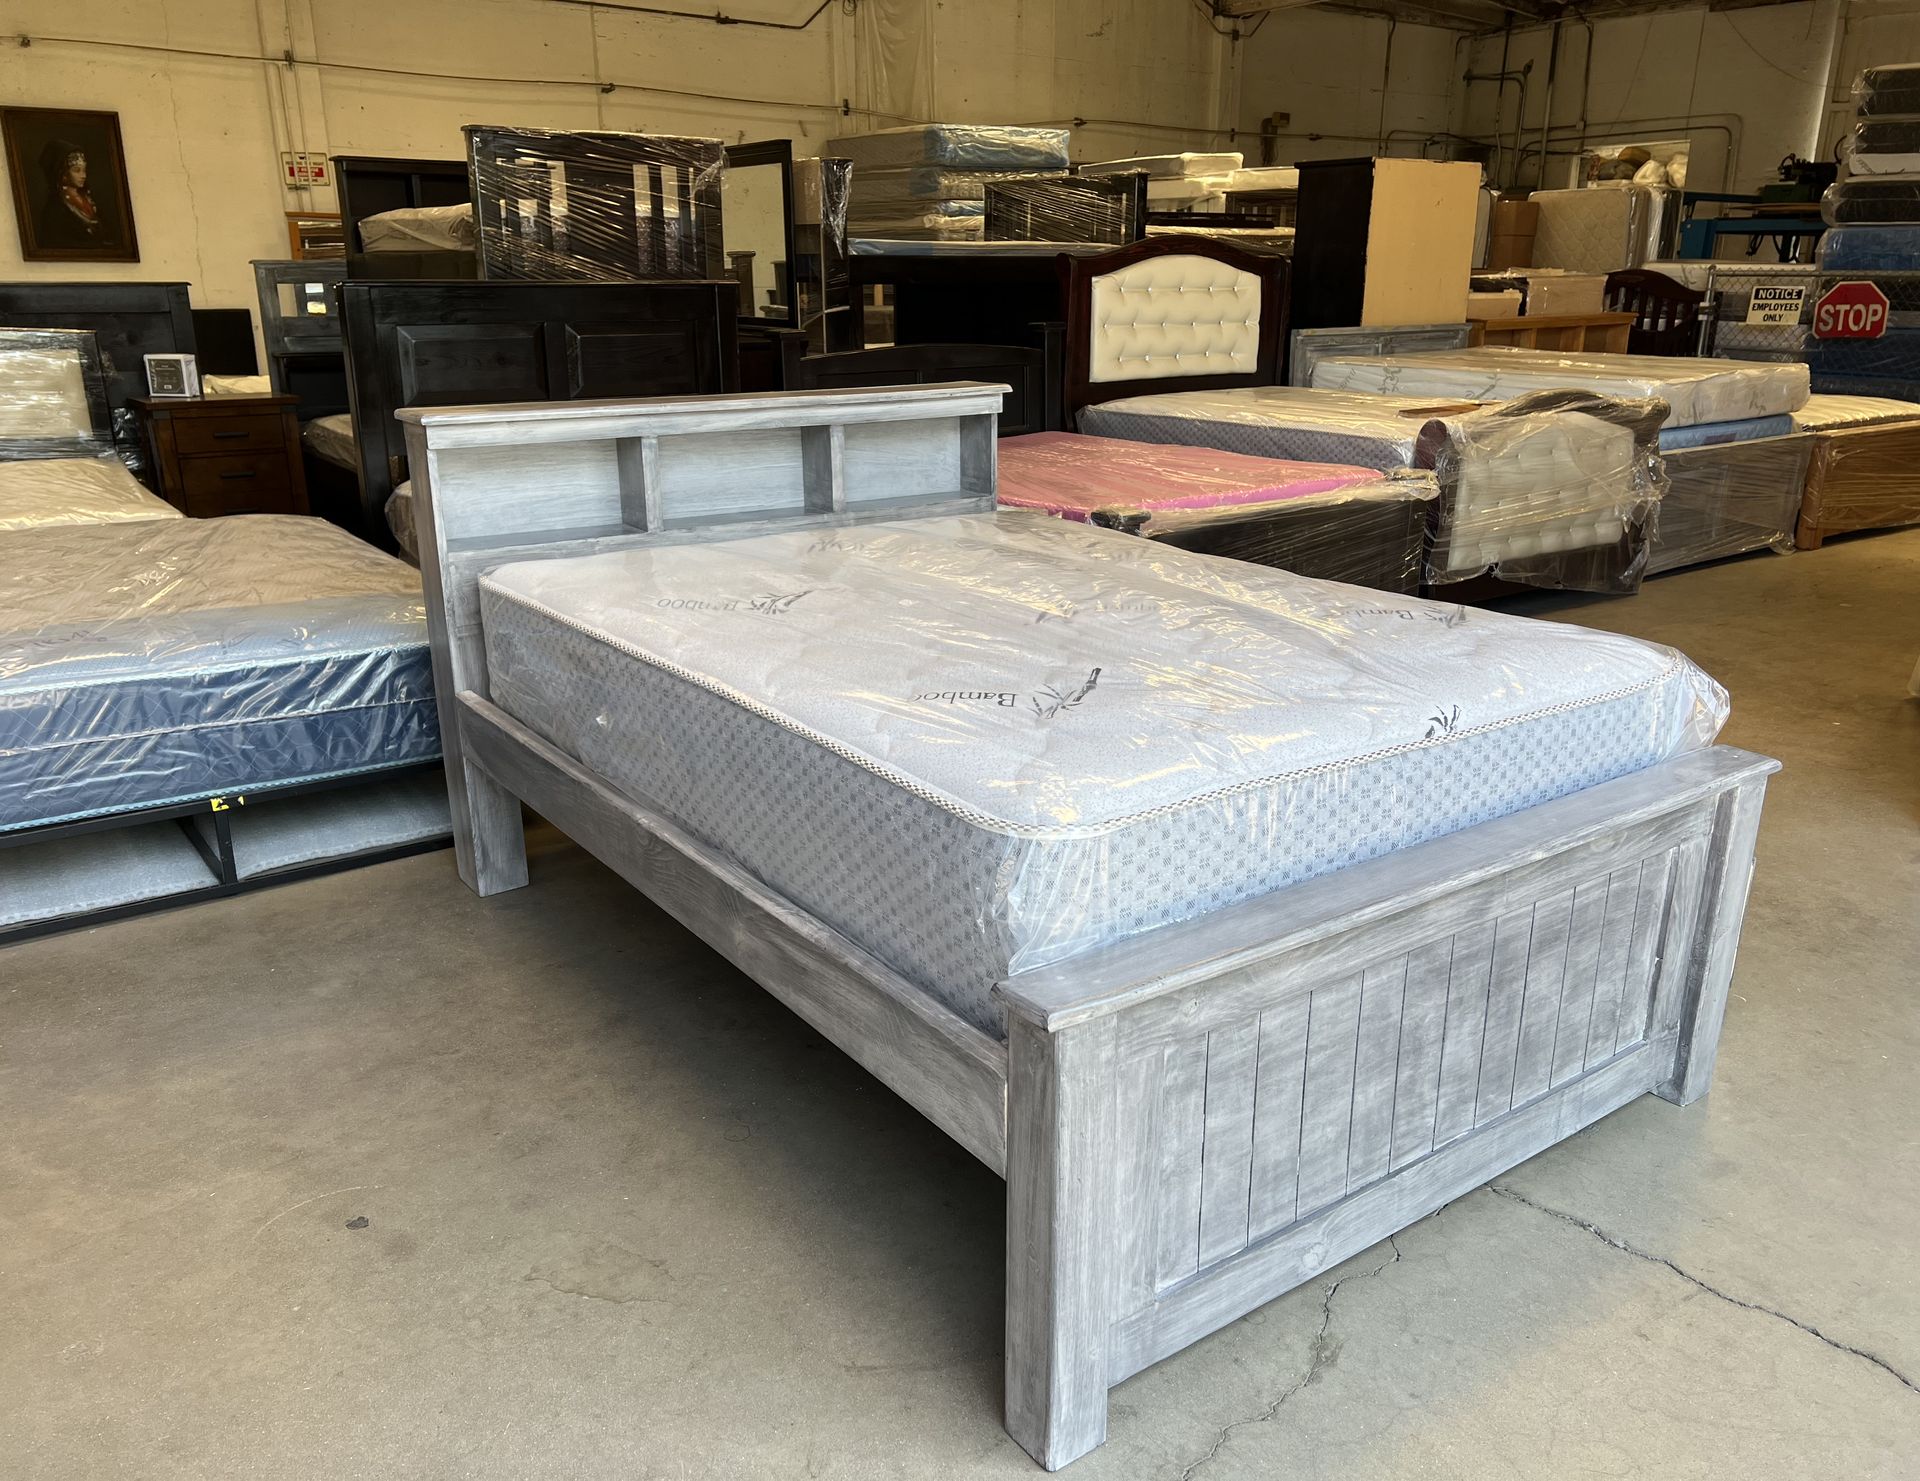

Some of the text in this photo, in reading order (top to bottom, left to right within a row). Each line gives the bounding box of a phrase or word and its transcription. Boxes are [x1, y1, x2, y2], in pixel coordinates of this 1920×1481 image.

[1758, 289, 1799, 299] NOTICE
[1752, 303, 1799, 311] EMPLOYEES
[1763, 314, 1783, 322] ONLY
[1819, 304, 1882, 332] STOP
